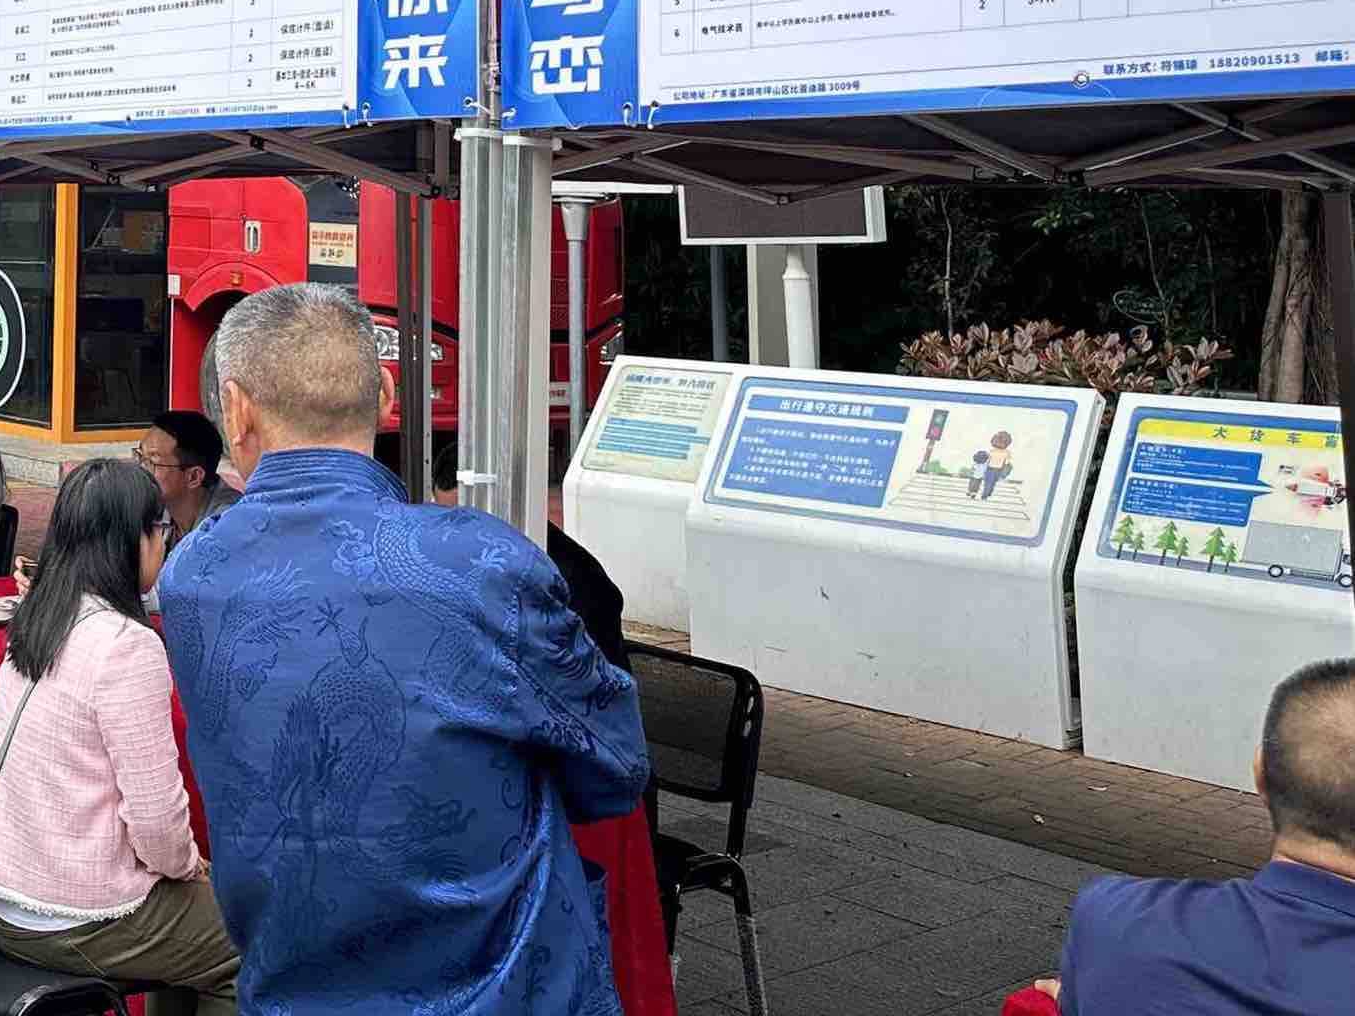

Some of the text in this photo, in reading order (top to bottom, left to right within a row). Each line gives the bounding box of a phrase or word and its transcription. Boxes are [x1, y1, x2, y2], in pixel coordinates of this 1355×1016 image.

[978, 0, 987, 10] 2
[779, 400, 875, 418] 出行遵守交通规则
